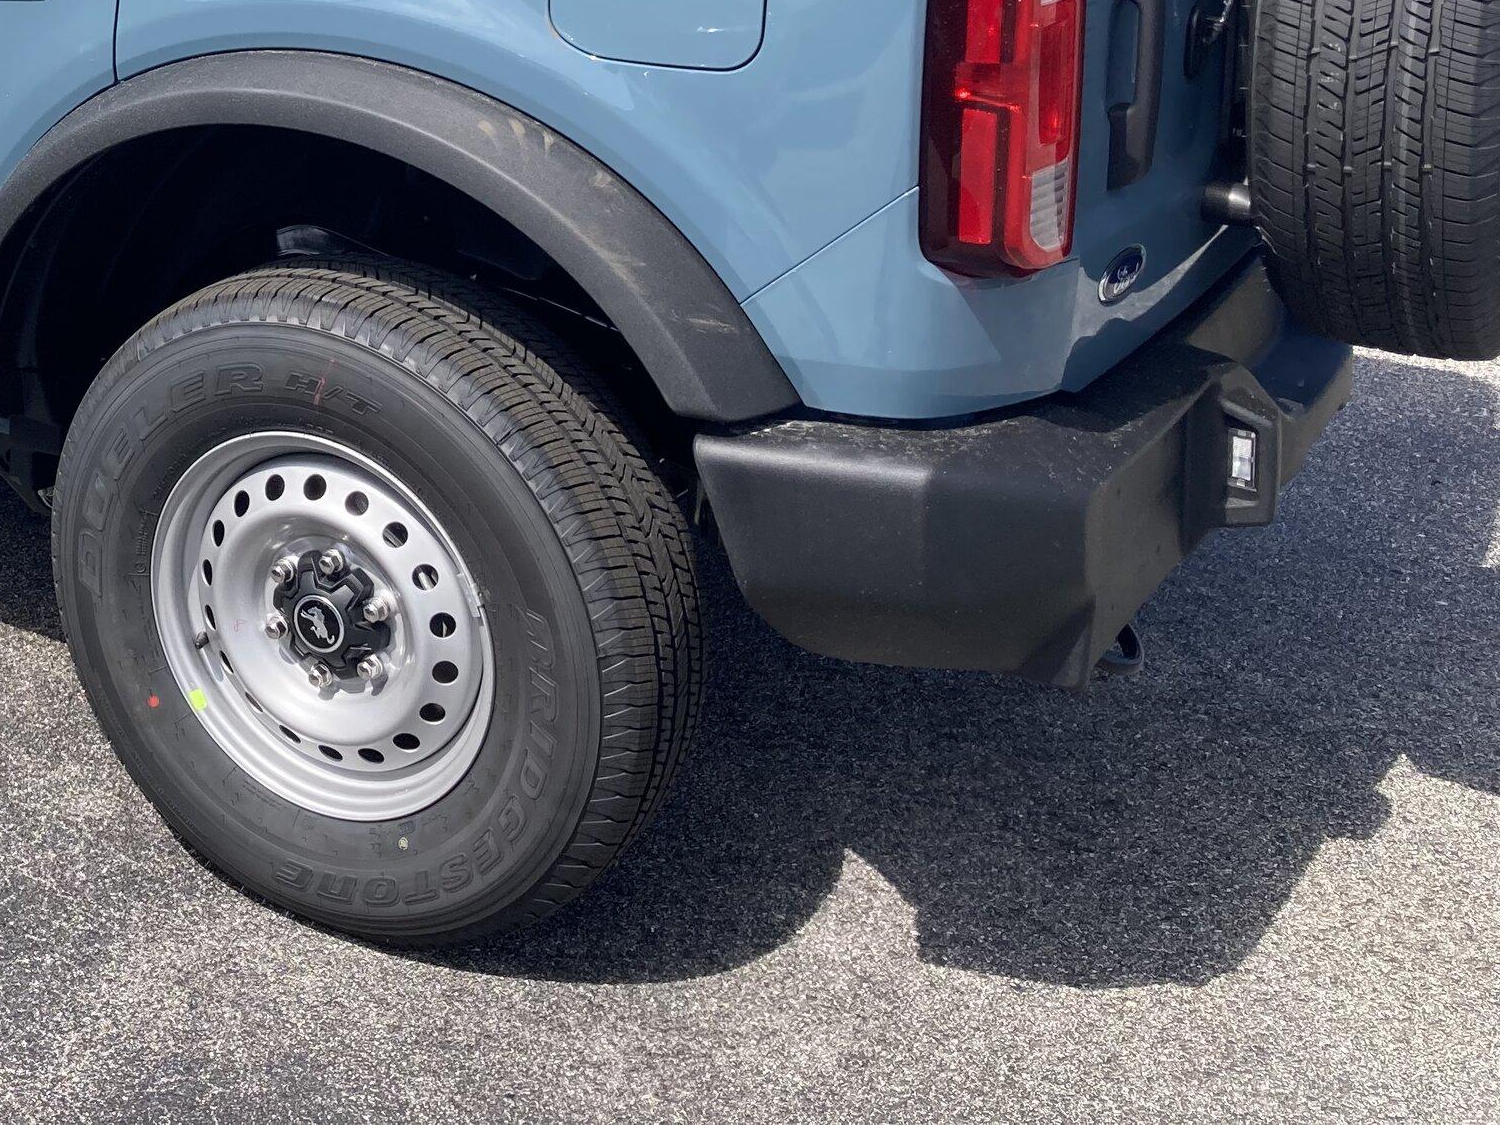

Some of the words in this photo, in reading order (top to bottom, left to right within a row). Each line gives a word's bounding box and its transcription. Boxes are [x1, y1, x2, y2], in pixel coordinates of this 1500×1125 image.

[77, 361, 265, 600] DUELER
[284, 369, 384, 418] H/T
[273, 607, 561, 909] BRIDGESTONE
